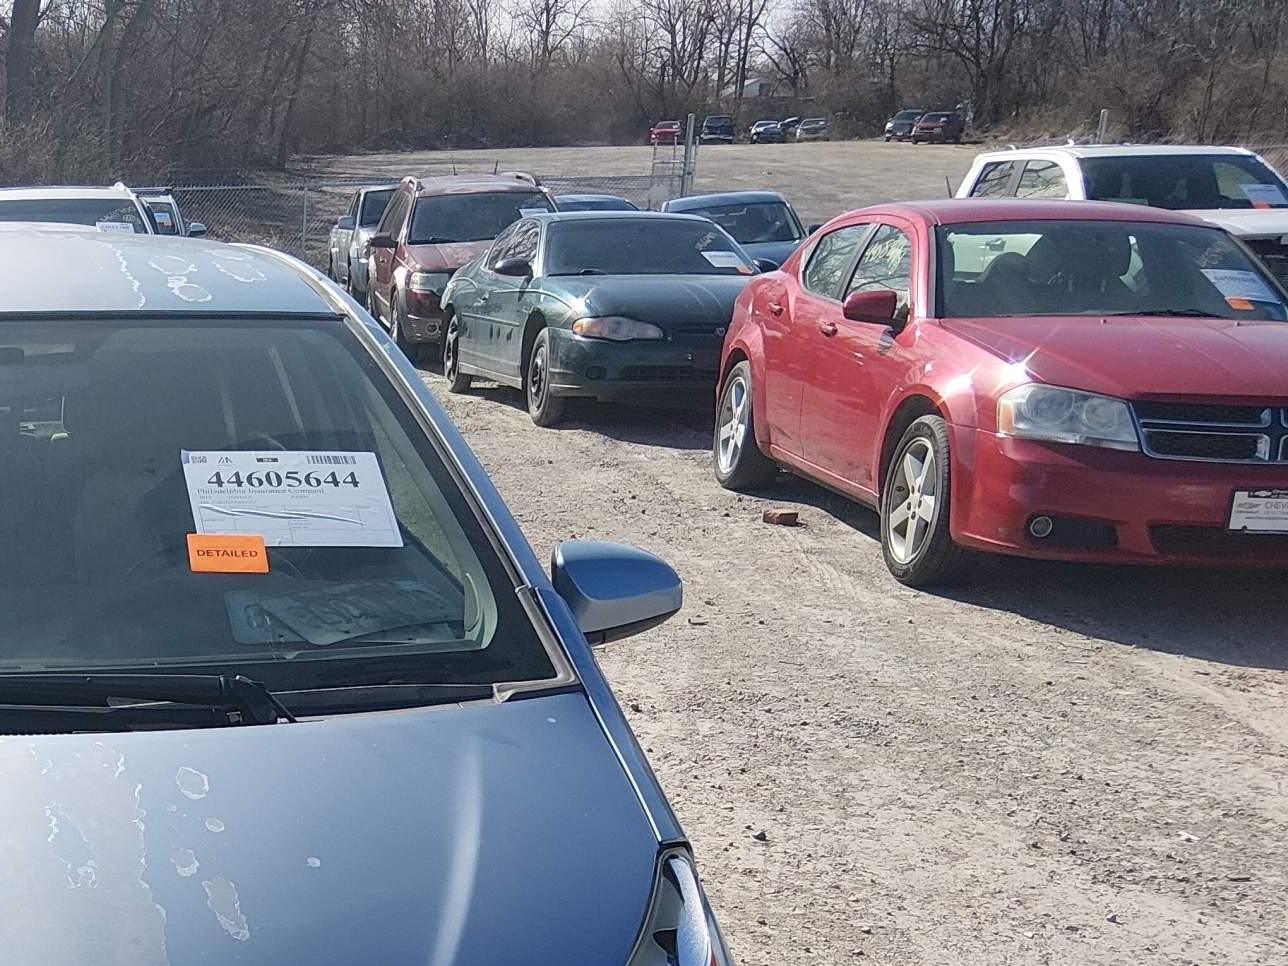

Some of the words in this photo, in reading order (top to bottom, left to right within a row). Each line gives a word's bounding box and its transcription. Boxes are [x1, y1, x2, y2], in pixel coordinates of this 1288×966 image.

[207, 470, 360, 488] 44605644
[1265, 501, 1288, 510] CHEV
[196, 549, 258, 558] DETAILED
